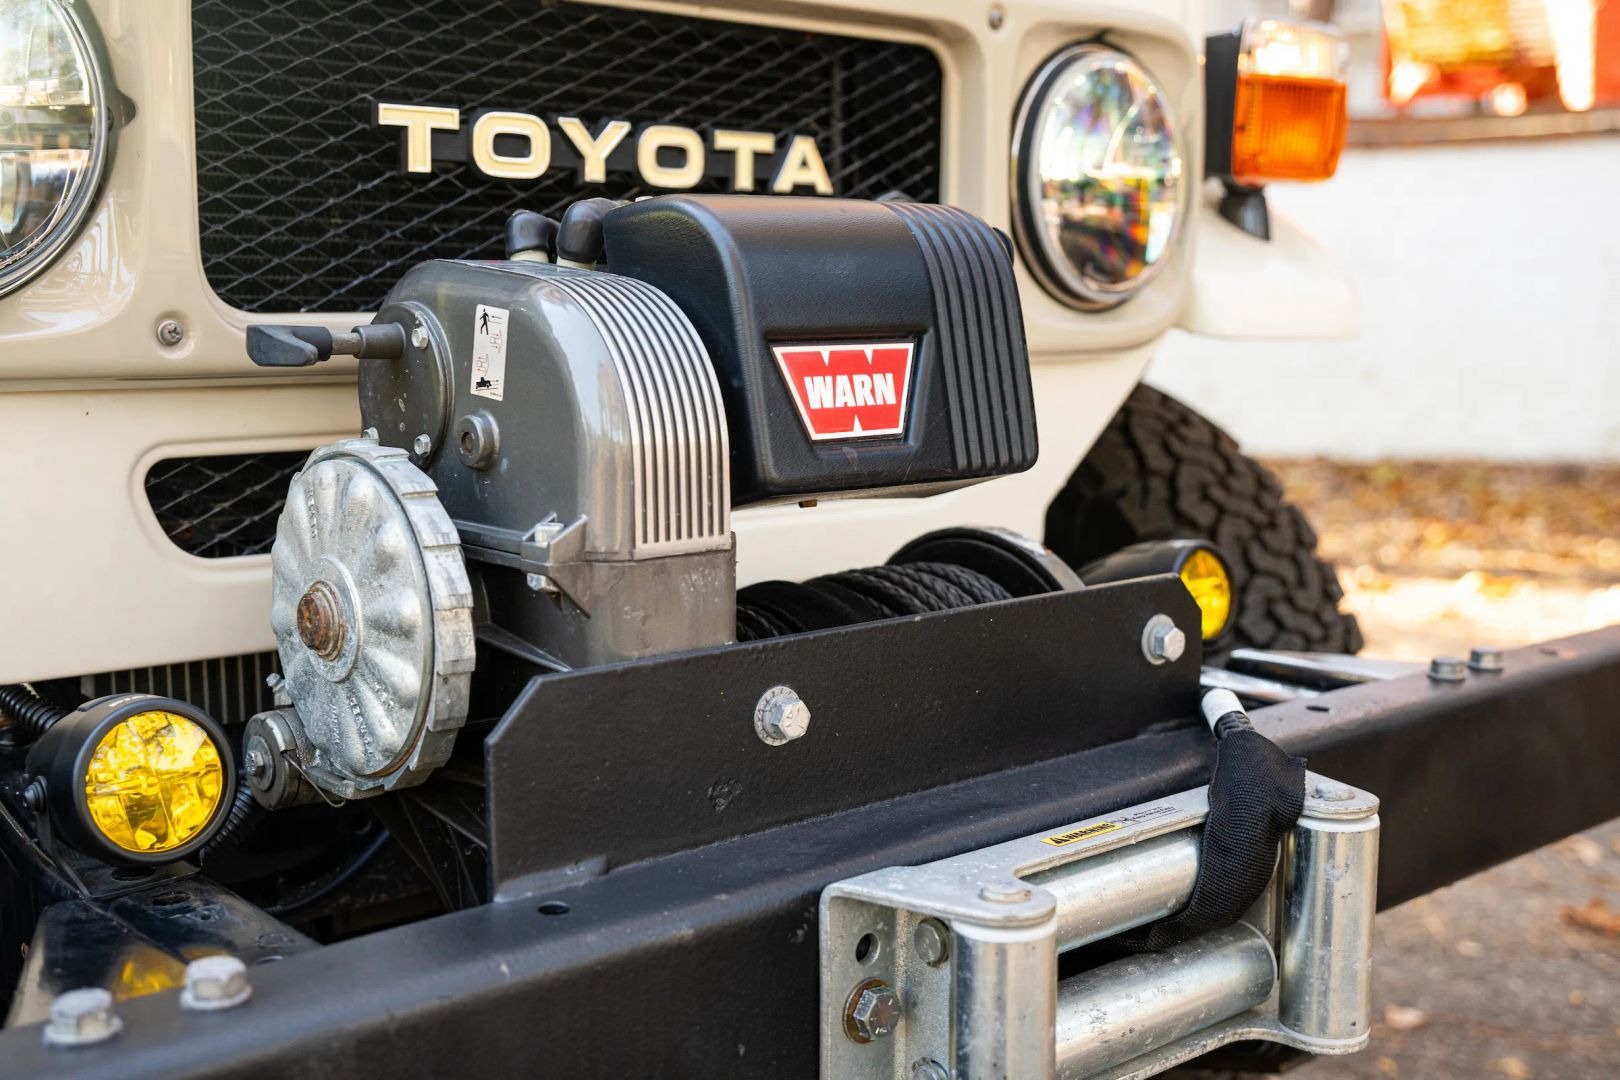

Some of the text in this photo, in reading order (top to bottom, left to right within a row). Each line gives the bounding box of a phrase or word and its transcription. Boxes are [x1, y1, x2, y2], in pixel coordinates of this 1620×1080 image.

[378, 103, 834, 195] TOYOTA
[803, 372, 897, 410] WARN
[1061, 822, 1116, 842] WARNING
